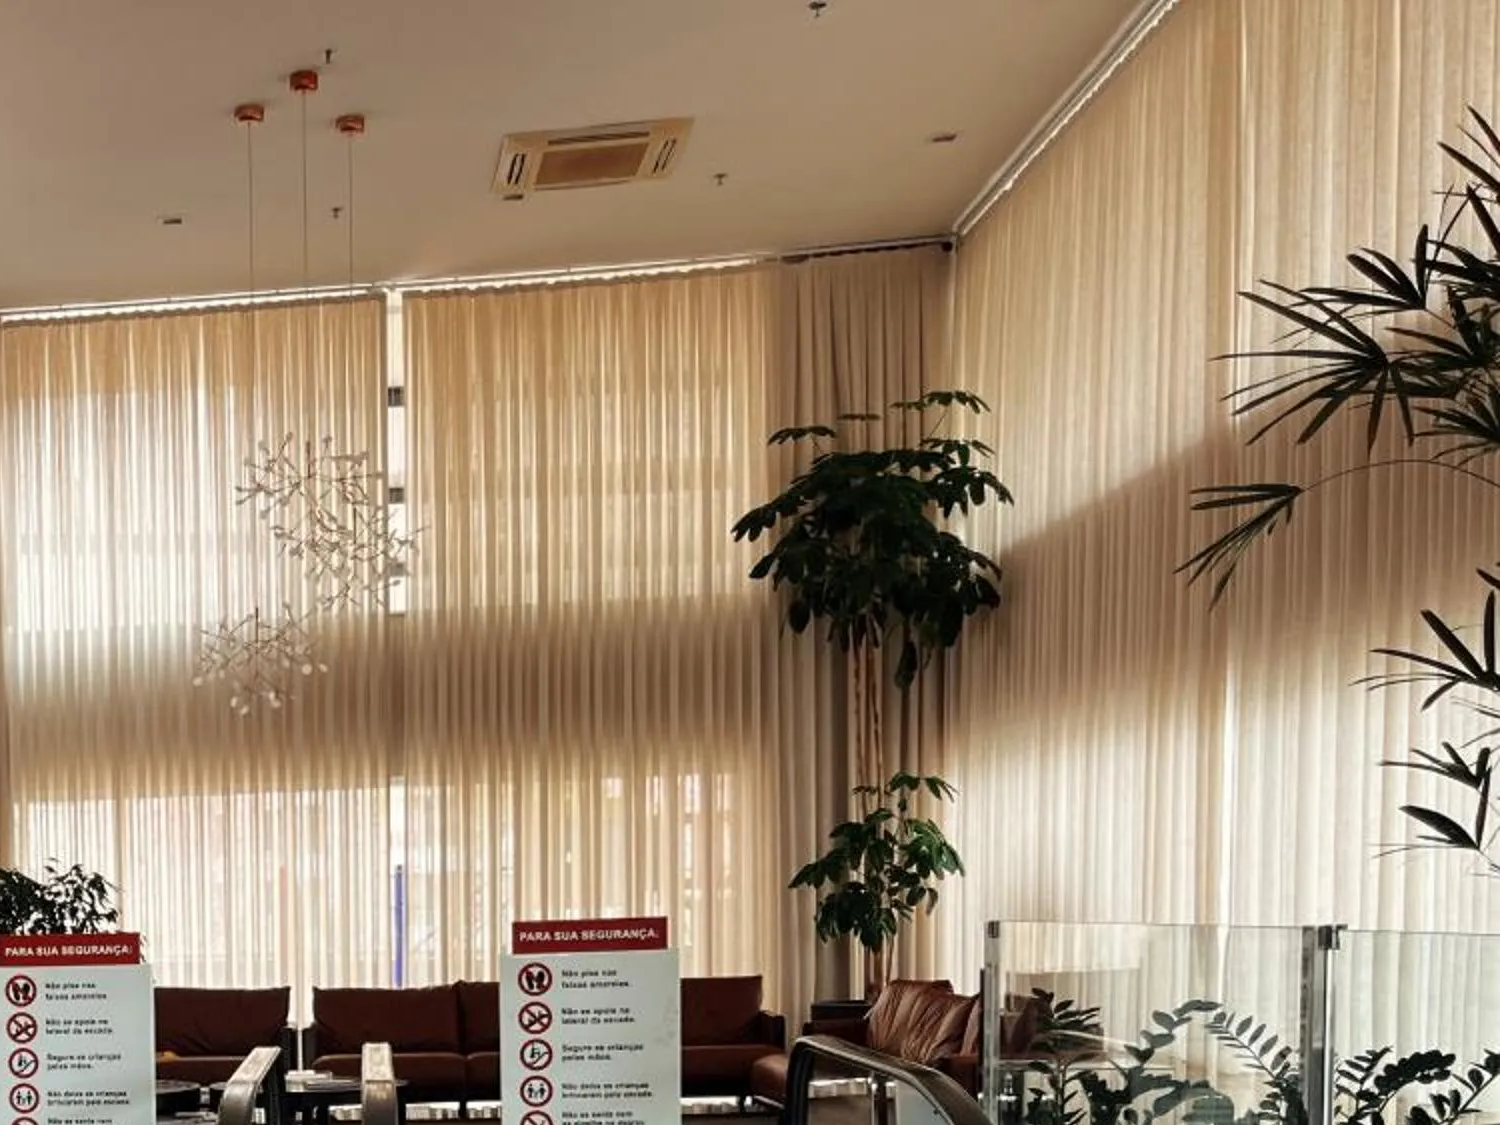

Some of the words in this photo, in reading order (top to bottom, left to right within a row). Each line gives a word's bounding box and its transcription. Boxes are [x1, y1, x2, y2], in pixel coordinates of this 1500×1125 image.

[519, 931, 552, 941] PARA
[553, 930, 579, 941] SUA
[4, 947, 35, 957] PARA
[36, 946, 59, 957] SUA
